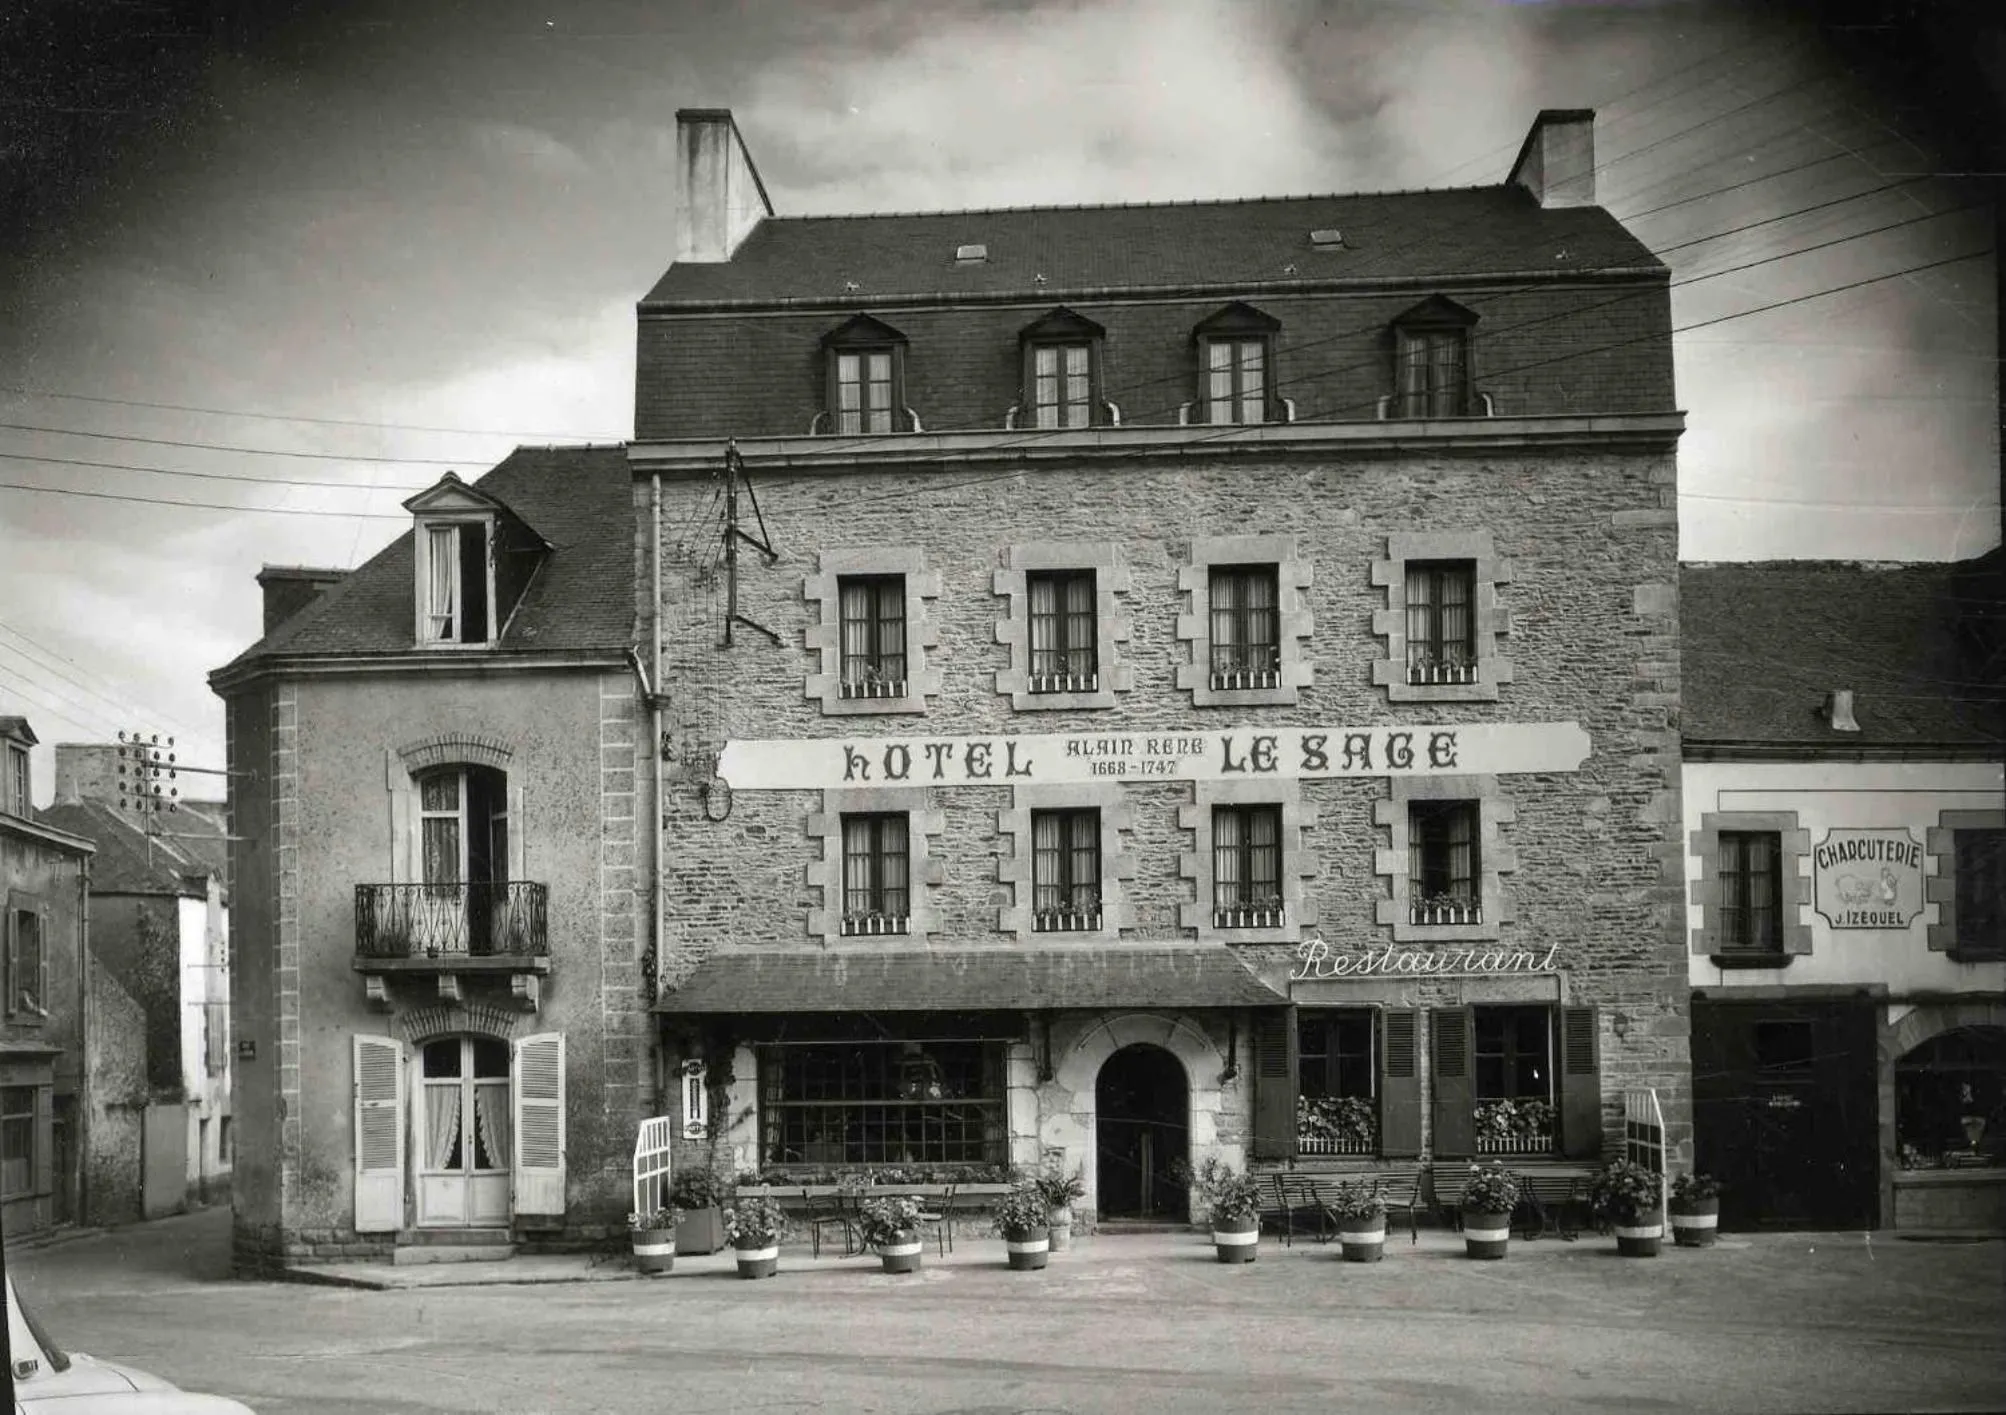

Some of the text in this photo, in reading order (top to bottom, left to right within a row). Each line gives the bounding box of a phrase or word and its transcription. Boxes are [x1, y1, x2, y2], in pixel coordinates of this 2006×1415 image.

[1066, 738, 1133, 756] ALAIN
[1221, 735, 1279, 774] LE
[1300, 731, 1458, 771] SAGE
[1818, 838, 1921, 870] CHARCUTERIE
[1289, 930, 1561, 979] Restaurant
